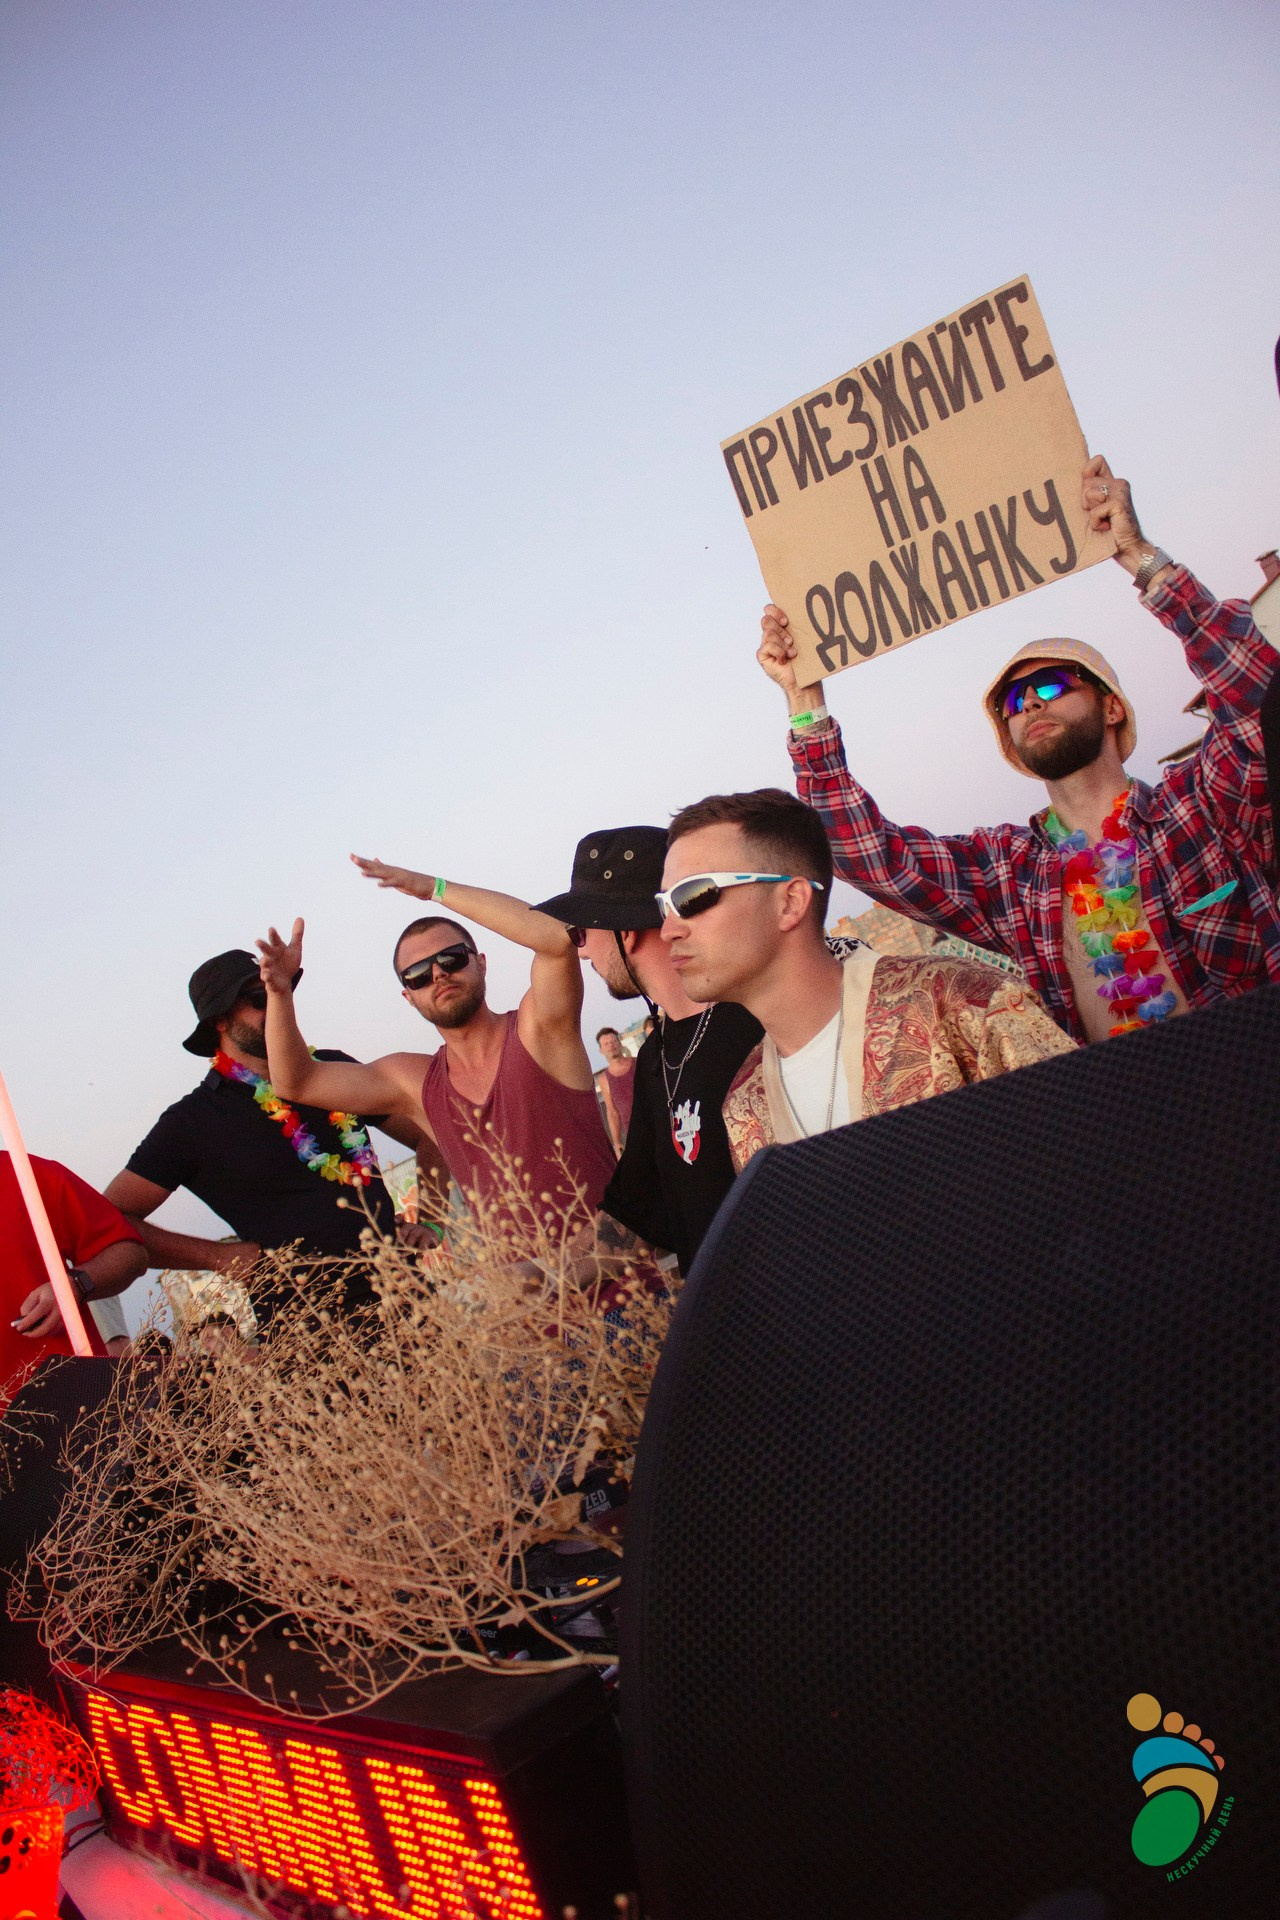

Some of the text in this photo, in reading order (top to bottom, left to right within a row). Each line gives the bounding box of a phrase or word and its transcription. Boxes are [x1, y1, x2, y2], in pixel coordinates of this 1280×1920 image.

[723, 281, 1055, 518] ПРИЕЗЖАЙТЕ
[860, 445, 947, 548] НА
[805, 479, 1077, 672] ДОЛЖАНКУ
[582, 1489, 607, 1510] ZED
